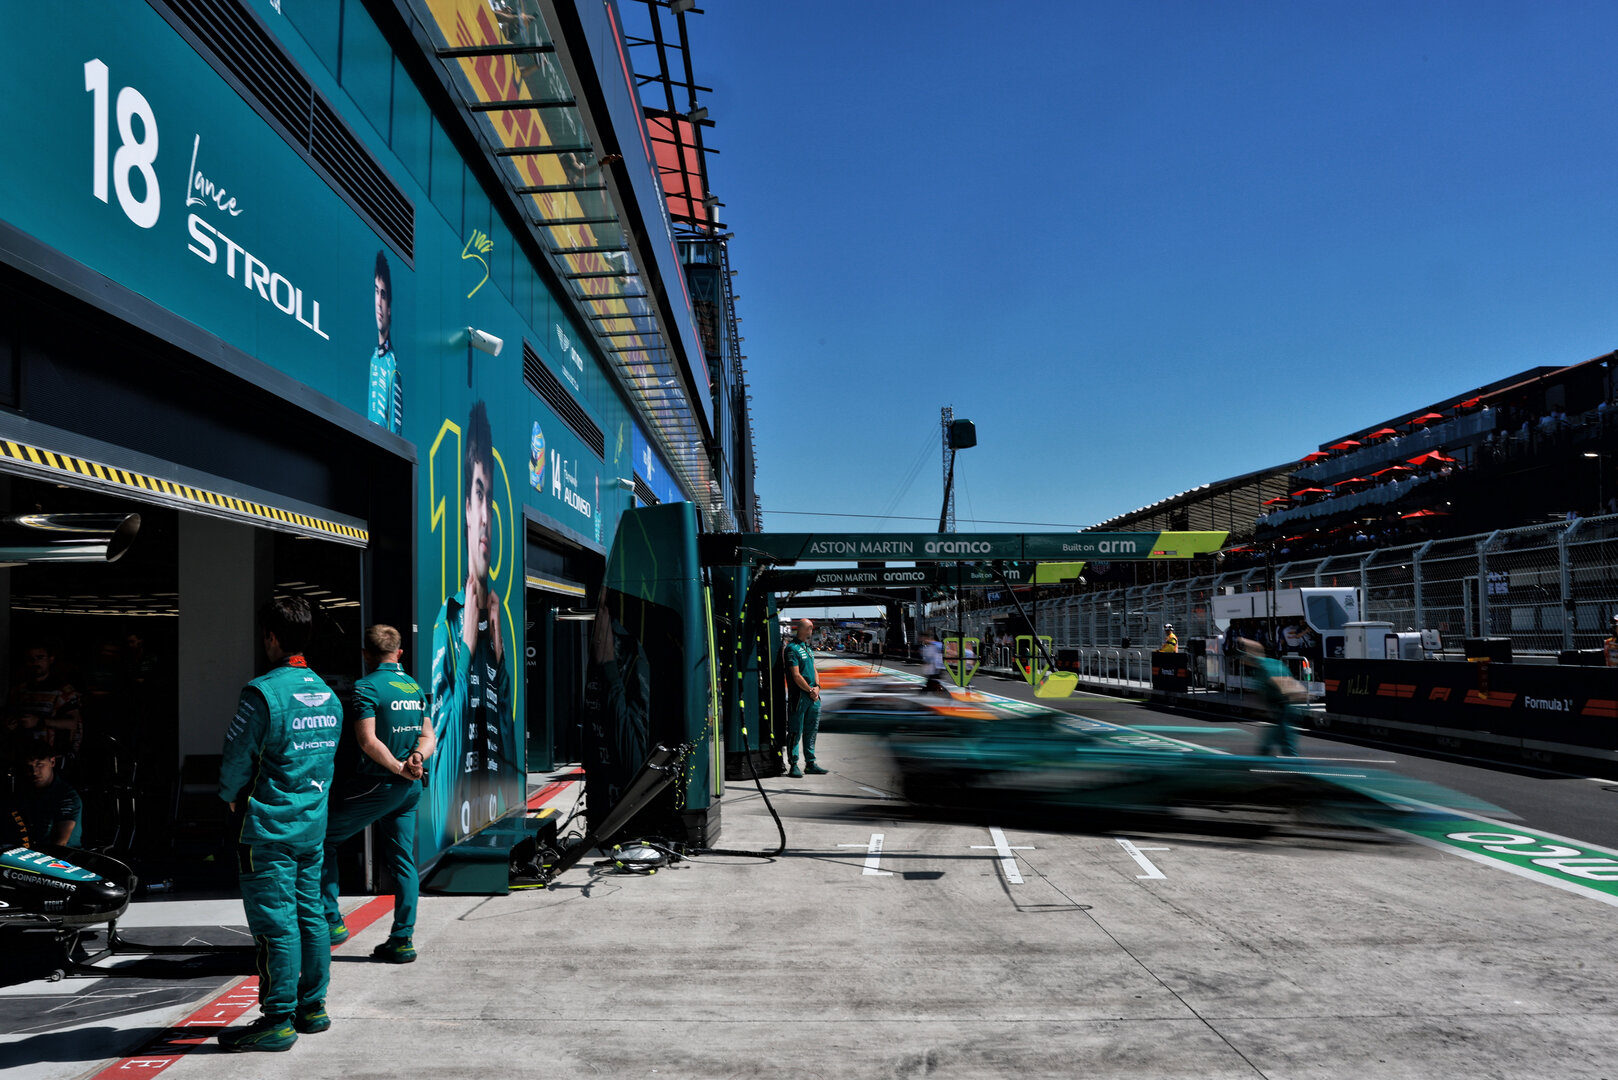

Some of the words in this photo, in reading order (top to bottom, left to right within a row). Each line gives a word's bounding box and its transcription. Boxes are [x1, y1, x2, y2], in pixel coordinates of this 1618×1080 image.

[84, 58, 161, 229] 18
[186, 133, 244, 216] Lance
[187, 213, 330, 341] STROLL
[551, 448, 562, 500] 14
[564, 487, 591, 518] ALONSO
[810, 541, 856, 553] ASTON
[860, 541, 913, 553] MARTIN
[925, 541, 991, 553] aramco
[1062, 543, 1081, 551] Built
[1098, 540, 1136, 553] arm
[816, 574, 843, 583] ASTON
[845, 573, 877, 582] MARTIN
[884, 572, 925, 581] aramco
[1003, 569, 1020, 579] rm
[1525, 696, 1562, 711] Formula
[292, 715, 337, 729] aramco
[11, 811, 27, 832] LEFT
[11, 872, 77, 892] COINPAYMENTS
